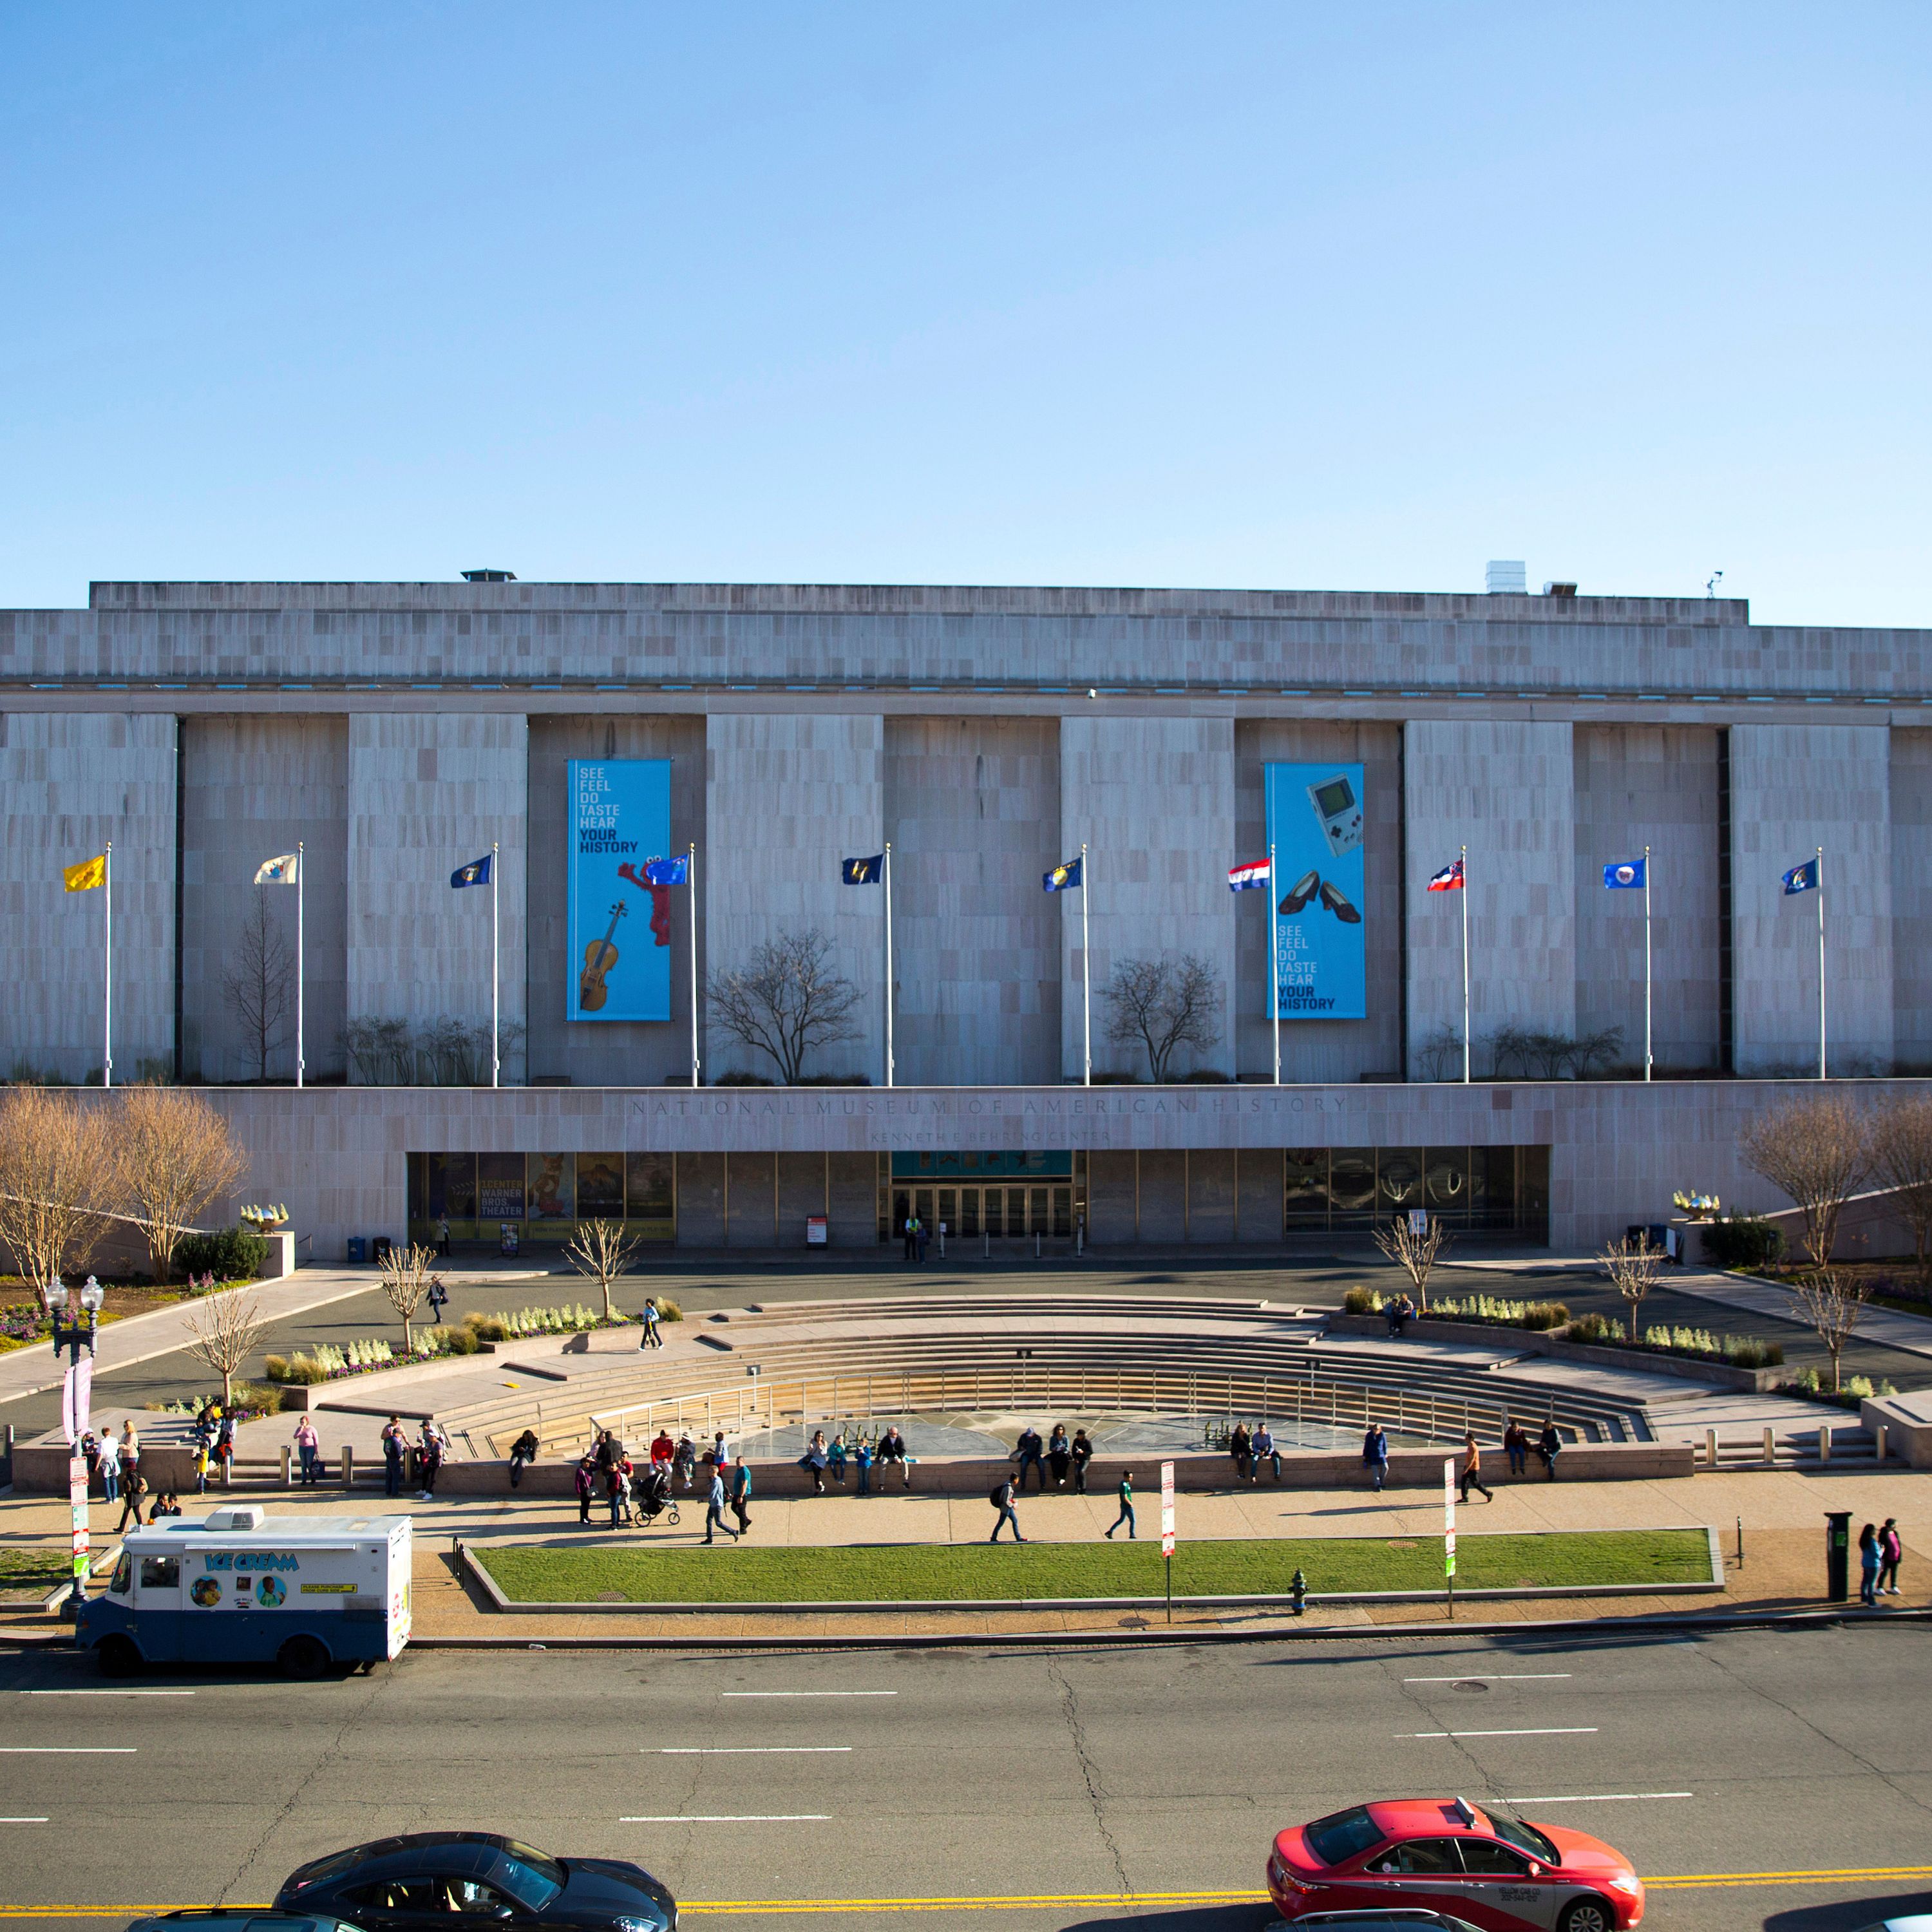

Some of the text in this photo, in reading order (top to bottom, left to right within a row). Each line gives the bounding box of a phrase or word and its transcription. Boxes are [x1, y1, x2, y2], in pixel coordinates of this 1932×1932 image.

[580, 768, 604, 779] SEE
[580, 781, 611, 791] FEEL
[580, 793, 598, 804] DO
[580, 805, 620, 816] TASTE
[580, 817, 616, 828] HEAR
[580, 829, 616, 840] YOUR
[580, 842, 638, 853] HISTORY
[1278, 925, 1302, 936] SEE
[1279, 938, 1309, 949] FEEL
[1279, 950, 1296, 961] DO
[1278, 962, 1317, 973] TASTE
[1278, 974, 1313, 985] HEAR
[1278, 986, 1314, 998] YOUR
[1278, 998, 1335, 1010] HISTORY
[632, 1098, 1346, 1115] NATIONAL MUSEUM OF AMERICAN HISTORY
[871, 1132, 945, 1142] KENNETH
[969, 1132, 1042, 1142] BEHRING
[1049, 1132, 1110, 1142] CENTER
[481, 1189, 522, 1197] WARNER
[482, 1198, 510, 1206] BROS.
[481, 1206, 522, 1215] THEATER
[204, 1552, 300, 1572] ICE CREAM
